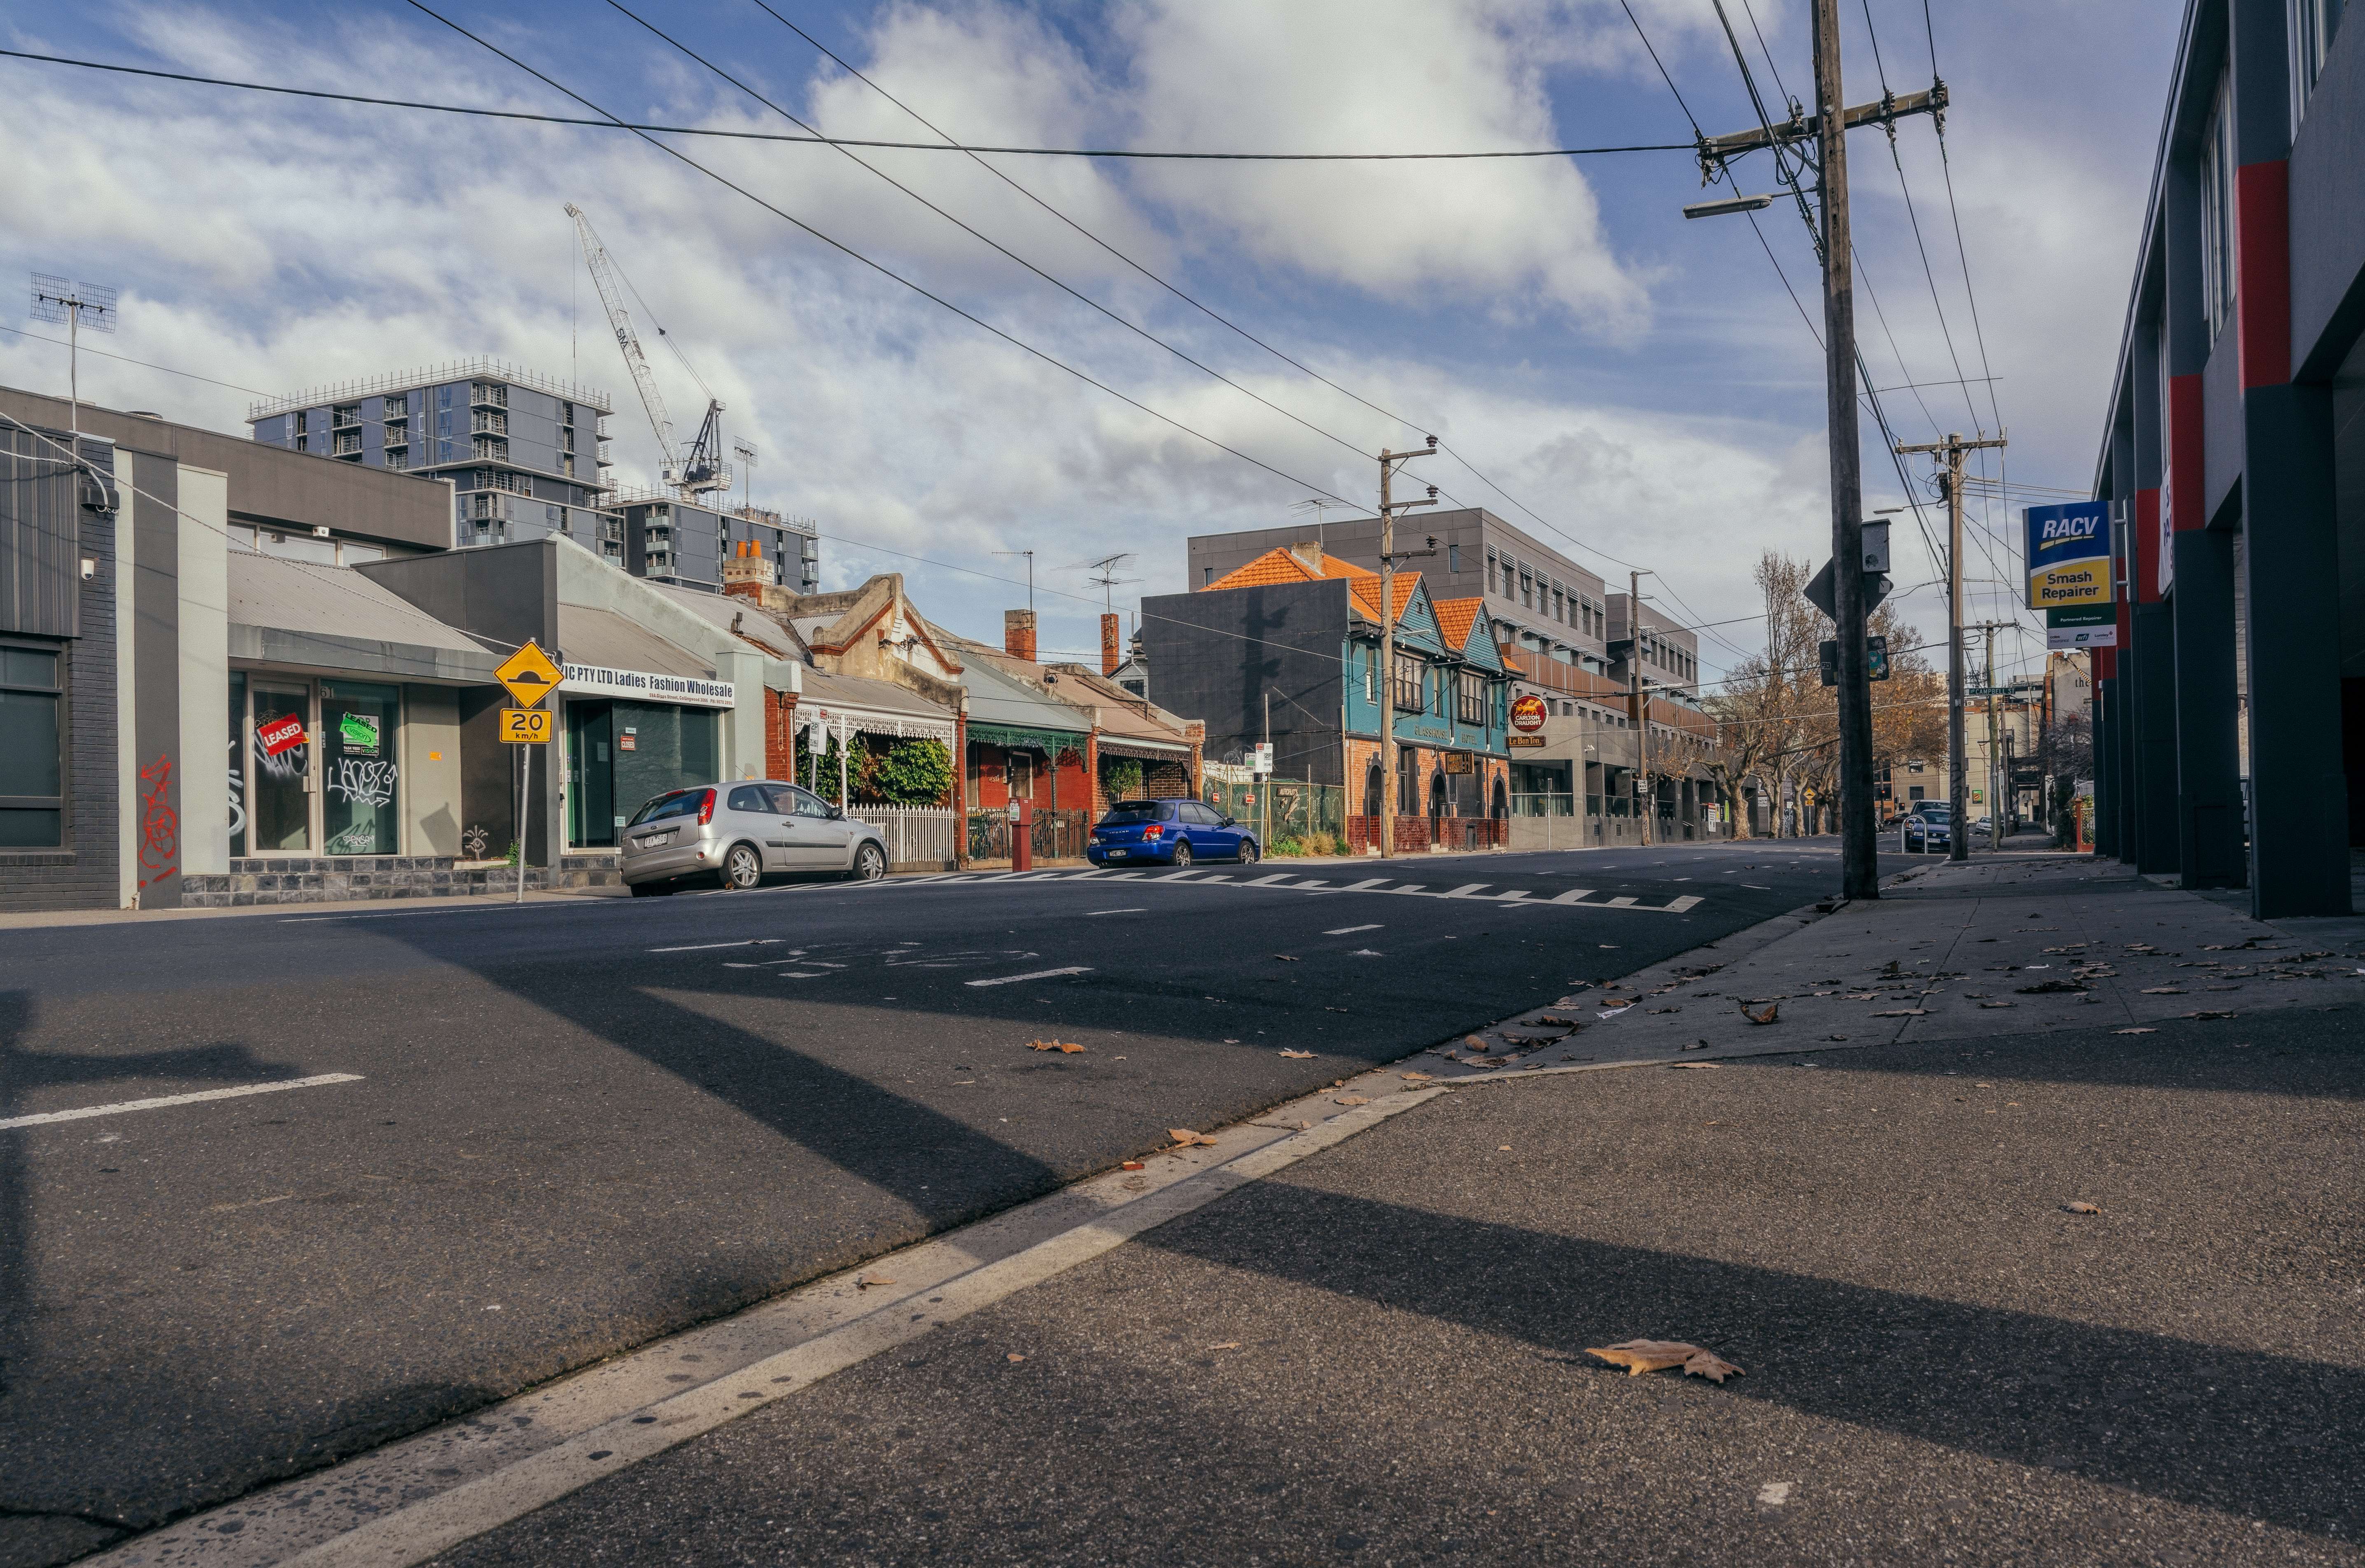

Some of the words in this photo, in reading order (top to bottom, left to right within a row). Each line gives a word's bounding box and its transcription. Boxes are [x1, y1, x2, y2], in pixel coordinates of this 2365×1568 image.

[2042, 516, 2099, 539] RACV
[2047, 571, 2092, 584] Smash
[2042, 586, 2099, 600] Repairer
[320, 687, 334, 698] 61
[578, 667, 595, 682] PTY
[597, 669, 612, 684] LTD
[615, 671, 646, 688] Ladies
[650, 676, 685, 693] Fashion
[687, 680, 732, 698] Wholesale
[345, 713, 377, 733] LEASED
[511, 714, 543, 731] 20
[264, 723, 301, 747] LEASED
[1414, 725, 1447, 740] GLASSHOUSE
[1462, 733, 1477, 745] HOTEL
